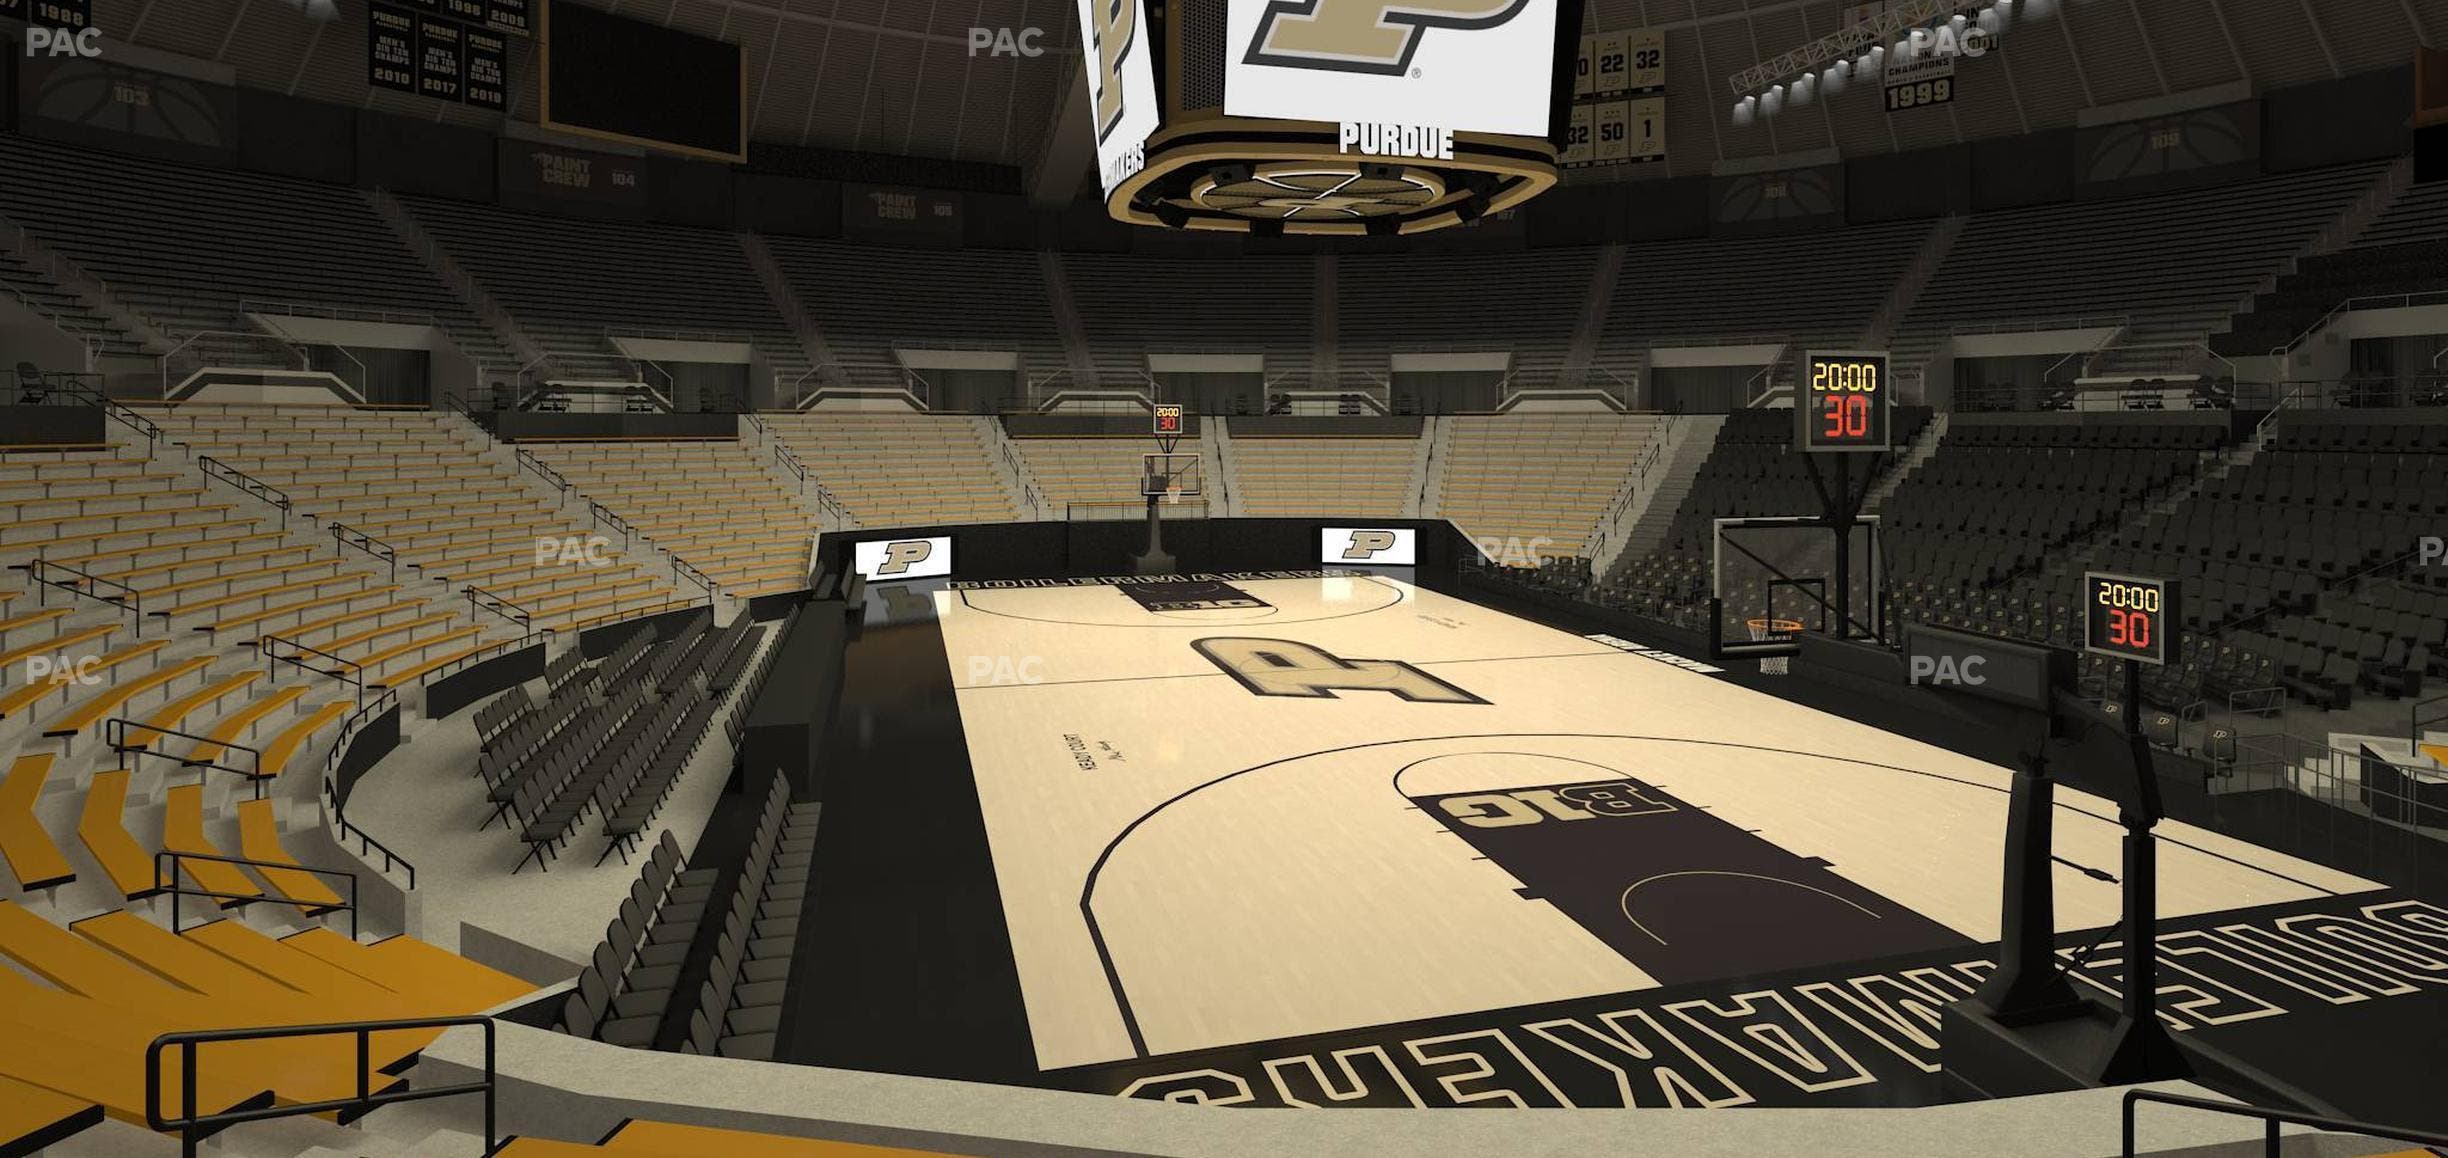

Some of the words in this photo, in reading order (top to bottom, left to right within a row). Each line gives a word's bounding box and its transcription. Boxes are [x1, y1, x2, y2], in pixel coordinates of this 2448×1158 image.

[39, 2, 84, 27] 1988
[372, 10, 411, 28] PURDUE
[491, 9, 526, 27] 2009
[422, 22, 459, 40] PURDUE
[468, 33, 503, 50] PURDUE
[1601, 53, 1624, 74] 22
[1636, 49, 1660, 69] 32
[1889, 57, 1949, 76] CHAMPIONS
[423, 78, 458, 95] 2017
[1888, 79, 1950, 110] 1999
[1340, 121, 1454, 159] PURDUE
[1601, 122, 1624, 141] 50
[540, 154, 593, 174] PAINT
[541, 169, 592, 188] CREW
[612, 172, 635, 187] 104
[1812, 362, 1876, 392] 20:00
[1156, 408, 1179, 417] 20:00
[1825, 394, 1867, 437] 30
[1160, 417, 1176, 430] 30
[2099, 582, 2159, 613] 20:00
[2110, 608, 2149, 649] 30
